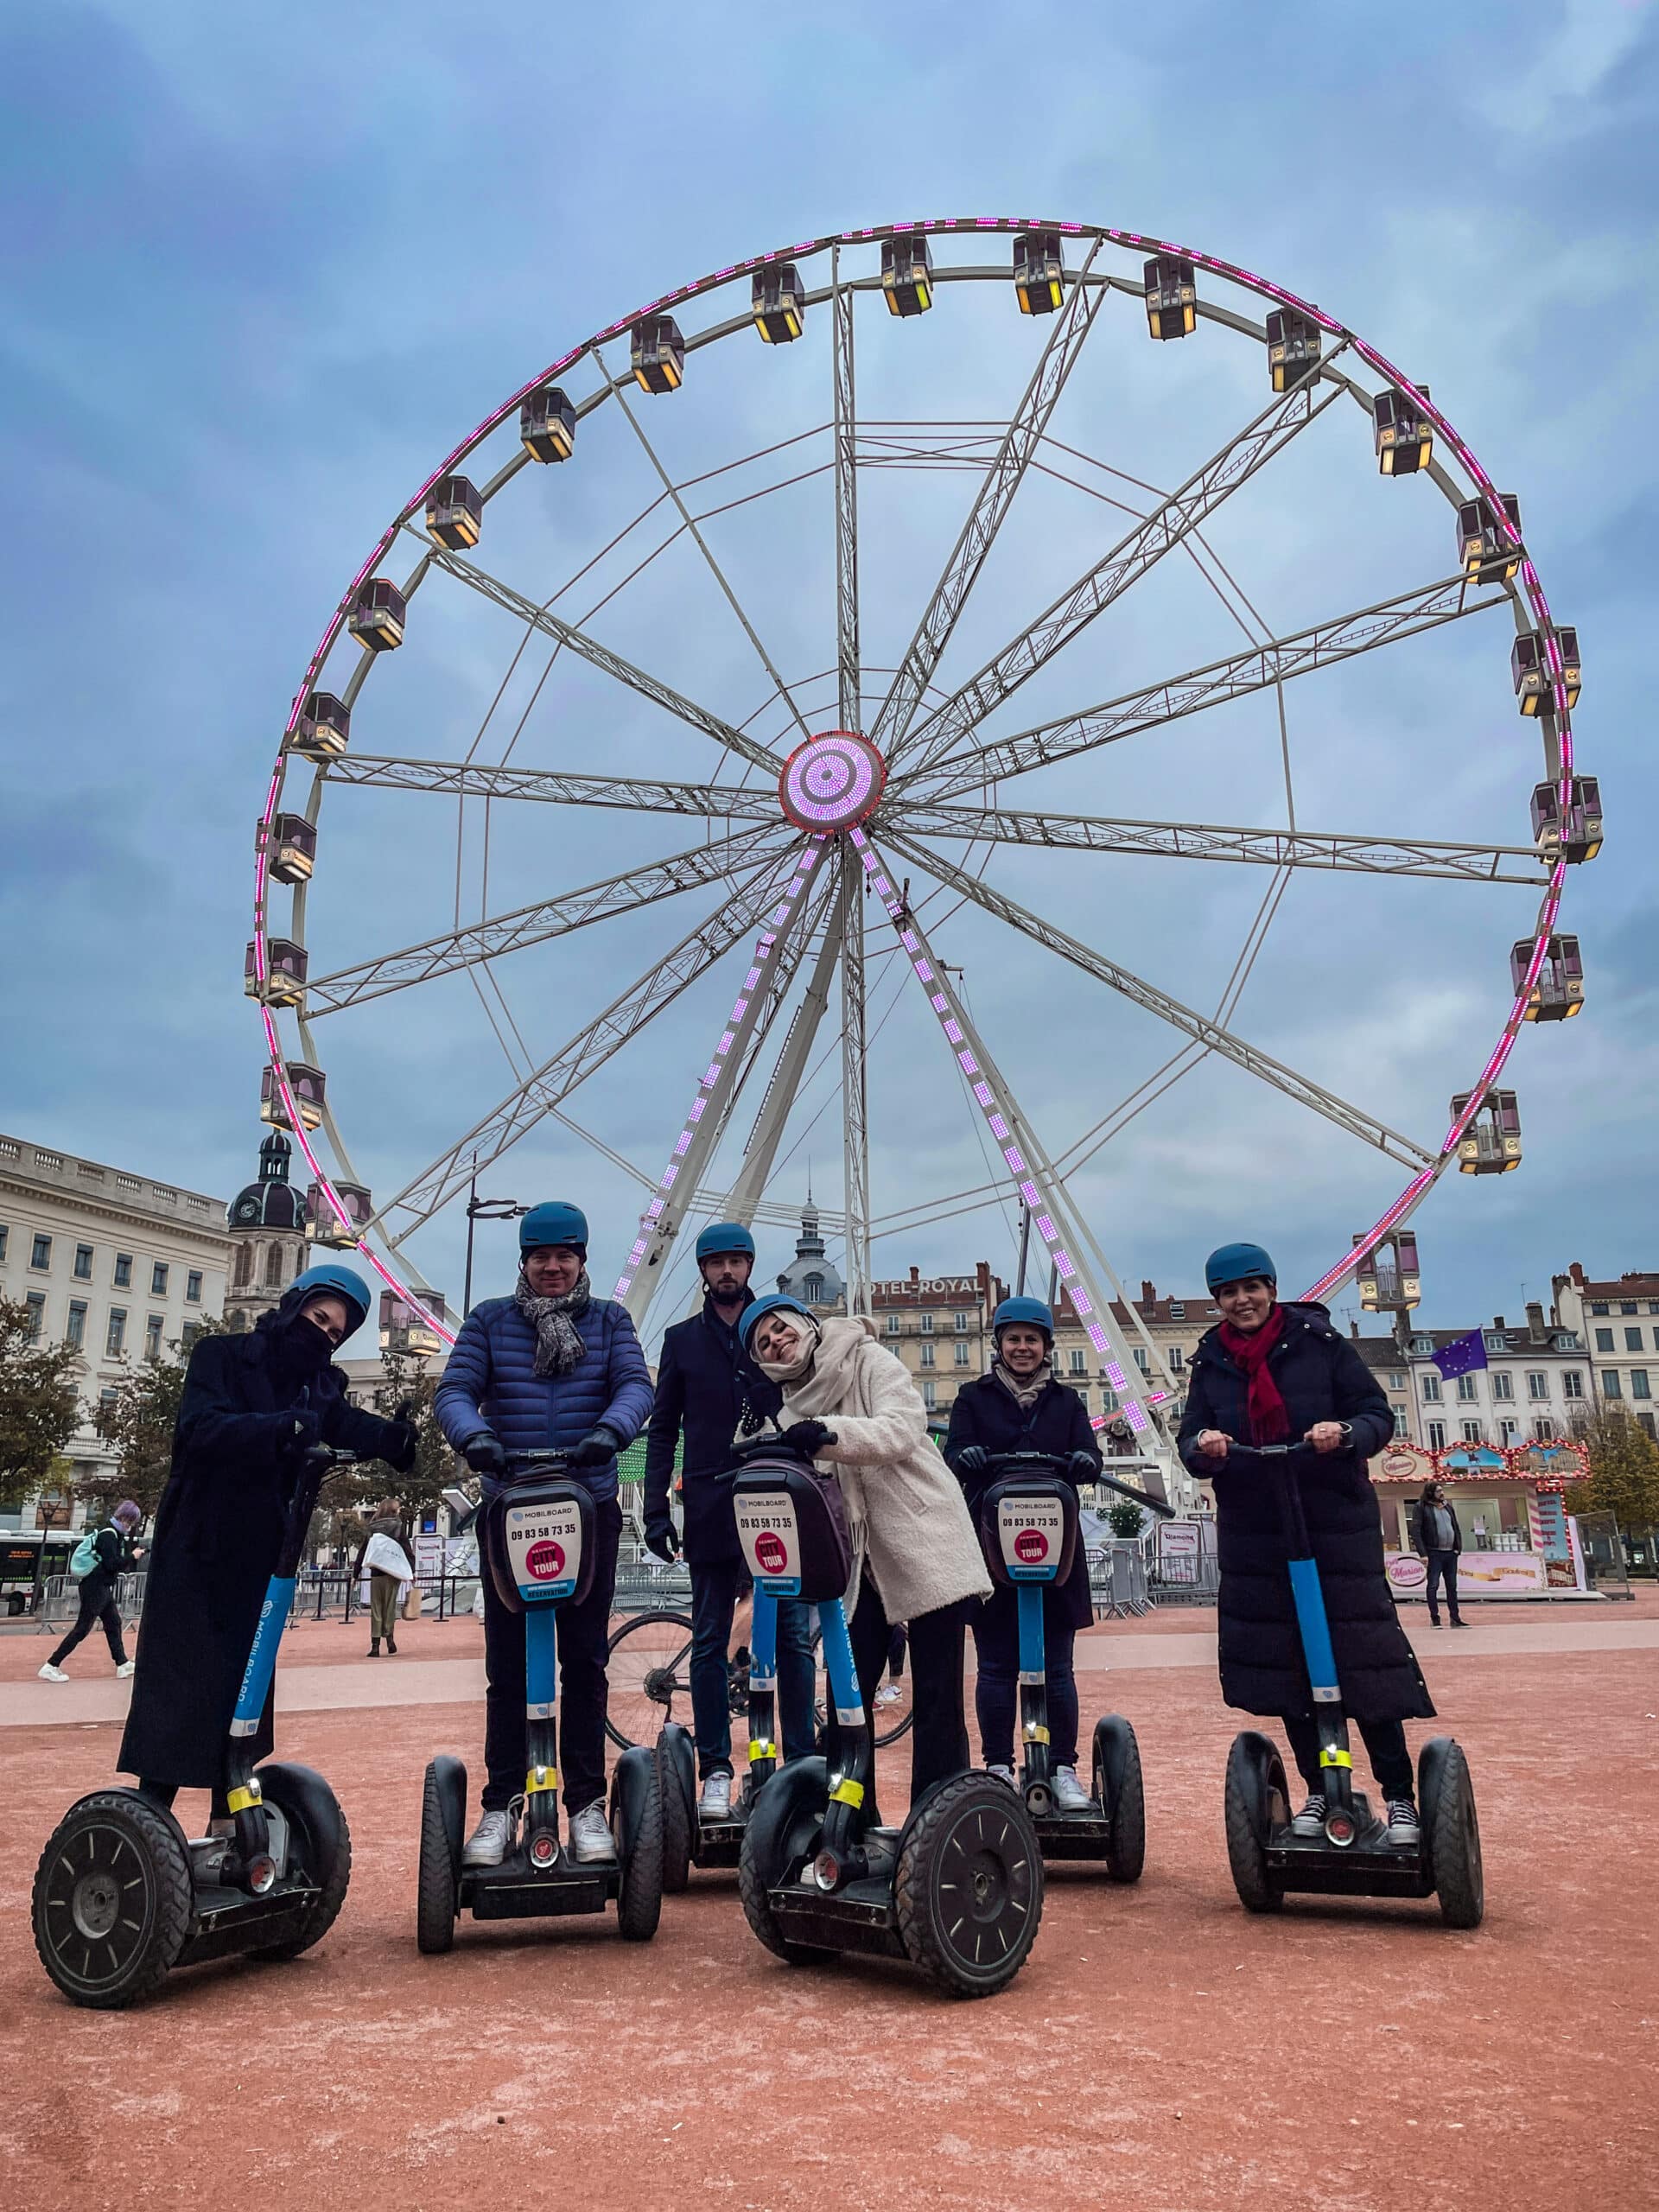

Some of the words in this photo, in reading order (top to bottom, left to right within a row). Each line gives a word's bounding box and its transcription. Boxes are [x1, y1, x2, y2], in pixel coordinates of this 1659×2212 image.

[870, 1279, 983, 1294] TEL-ROYAL
[524, 1508, 573, 1518] MOBILBOARD
[741, 1518, 749, 1528] 09
[751, 1518, 760, 1528] 83
[760, 1518, 770, 1528] 58
[772, 1518, 780, 1528] 73
[783, 1518, 791, 1528] 35
[512, 1530, 523, 1541] 09
[525, 1529, 536, 1539] 83
[538, 1527, 549, 1537] 58
[551, 1525, 563, 1535] 73
[565, 1523, 575, 1534] 35
[532, 1548, 556, 1566] CITY
[1021, 1548, 1042, 1558] TOUR
[534, 1560, 559, 1575] TOUR
[762, 1554, 784, 1568] TOUR
[238, 1620, 265, 1702] MOBILBOARD
